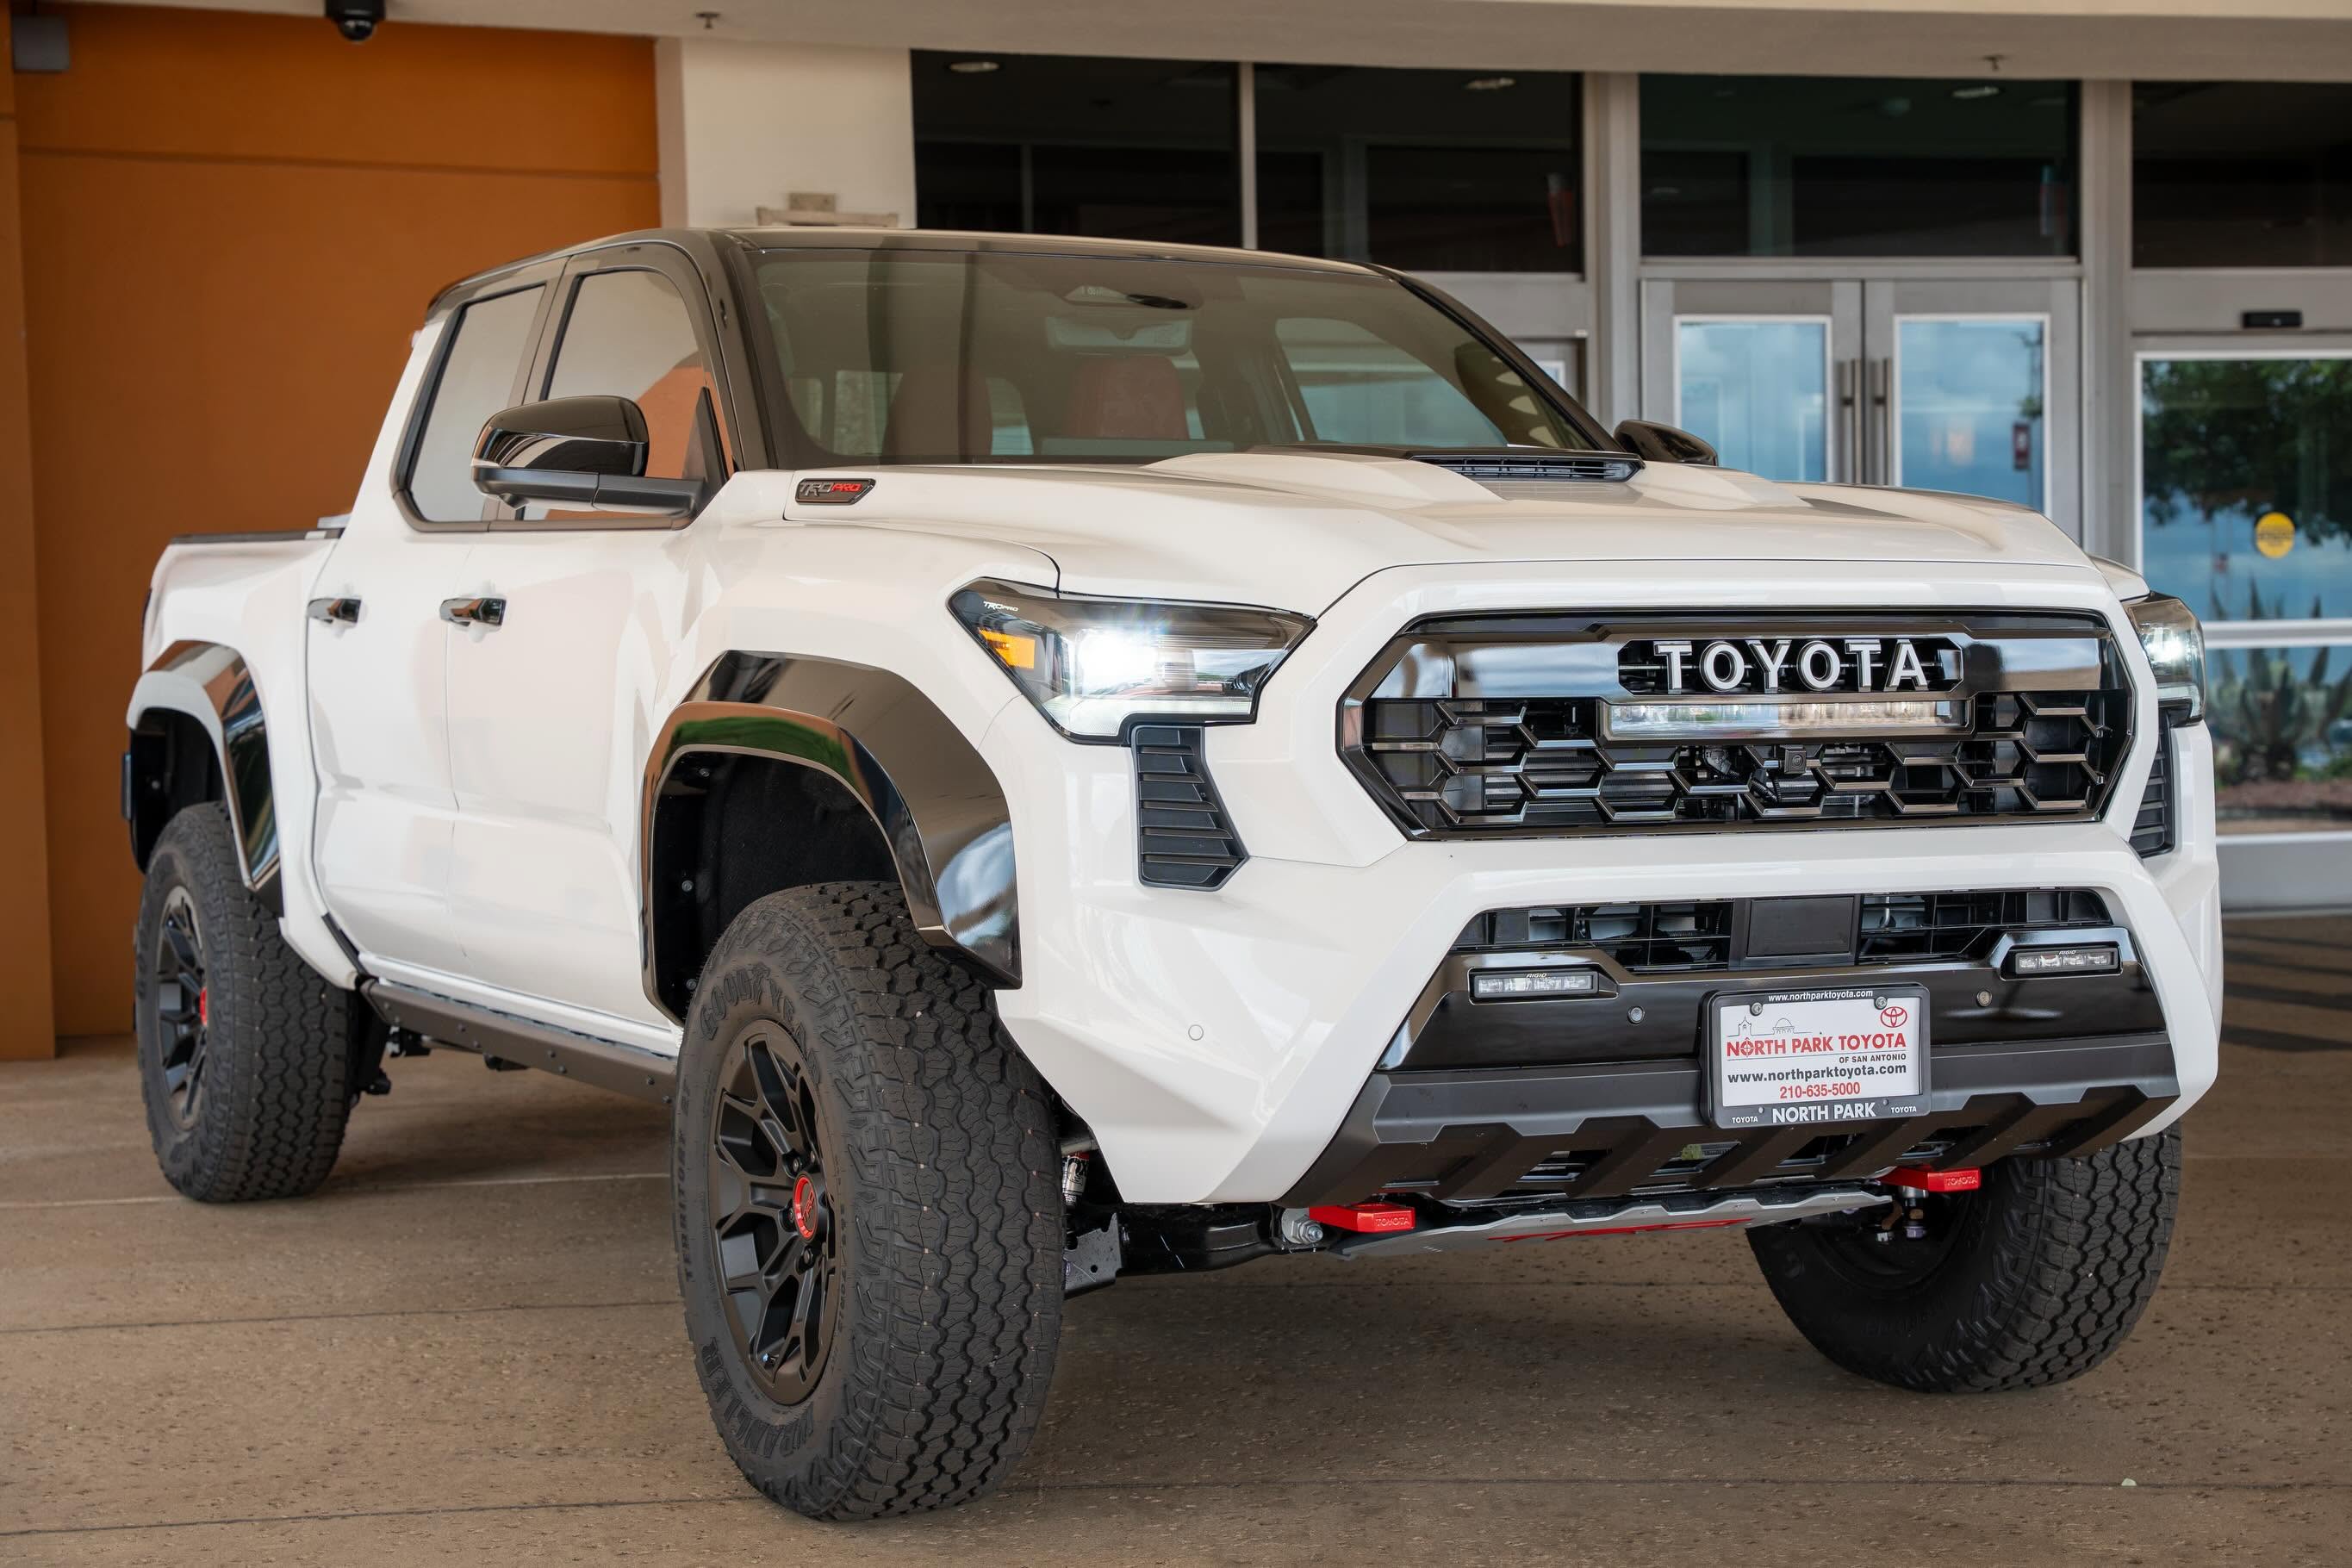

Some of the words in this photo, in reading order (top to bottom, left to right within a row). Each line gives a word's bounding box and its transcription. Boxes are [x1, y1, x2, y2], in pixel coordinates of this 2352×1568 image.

[1653, 639, 1929, 693] TOYOTA
[1768, 990, 1874, 1002] www.northparktoyota.com
[1727, 1037, 1786, 1058] NORTH
[1792, 1036, 1833, 1055] PARK
[1839, 1032, 1907, 1050] TOYOTA
[1870, 1053, 1907, 1061] ANTONIO
[1727, 1063, 1907, 1083] www.northparktoyota.com
[1779, 1082, 1861, 1099] 210-635-5000
[1772, 1105, 1828, 1123] NORTH
[1833, 1102, 1876, 1119] PARK
[1891, 1105, 1917, 1114] TOYOTA
[1946, 1176, 1977, 1185] TOYOTA
[1376, 1217, 1409, 1227] TOYOTA
